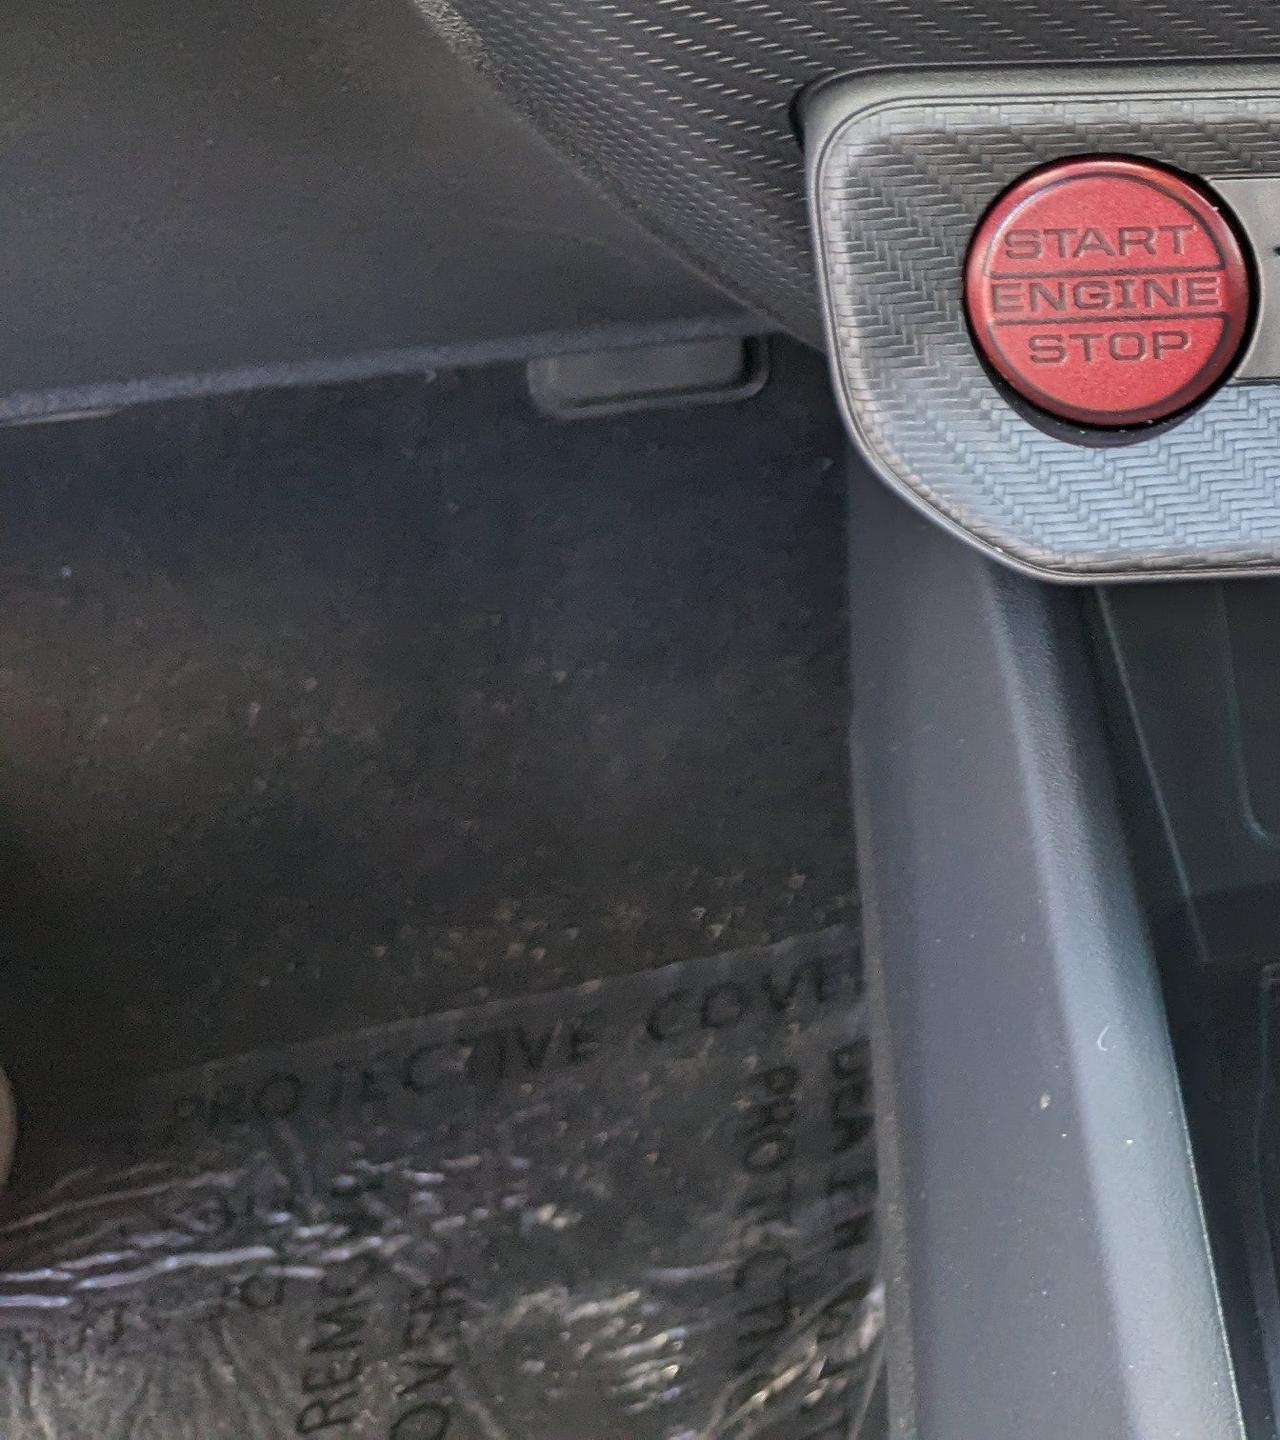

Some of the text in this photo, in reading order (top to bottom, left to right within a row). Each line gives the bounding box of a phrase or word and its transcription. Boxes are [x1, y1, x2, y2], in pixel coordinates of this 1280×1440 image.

[1005, 225, 1193, 259] START
[992, 276, 1220, 314] ENGINE
[1029, 331, 1188, 363] STOP
[647, 951, 864, 1042] COVE
